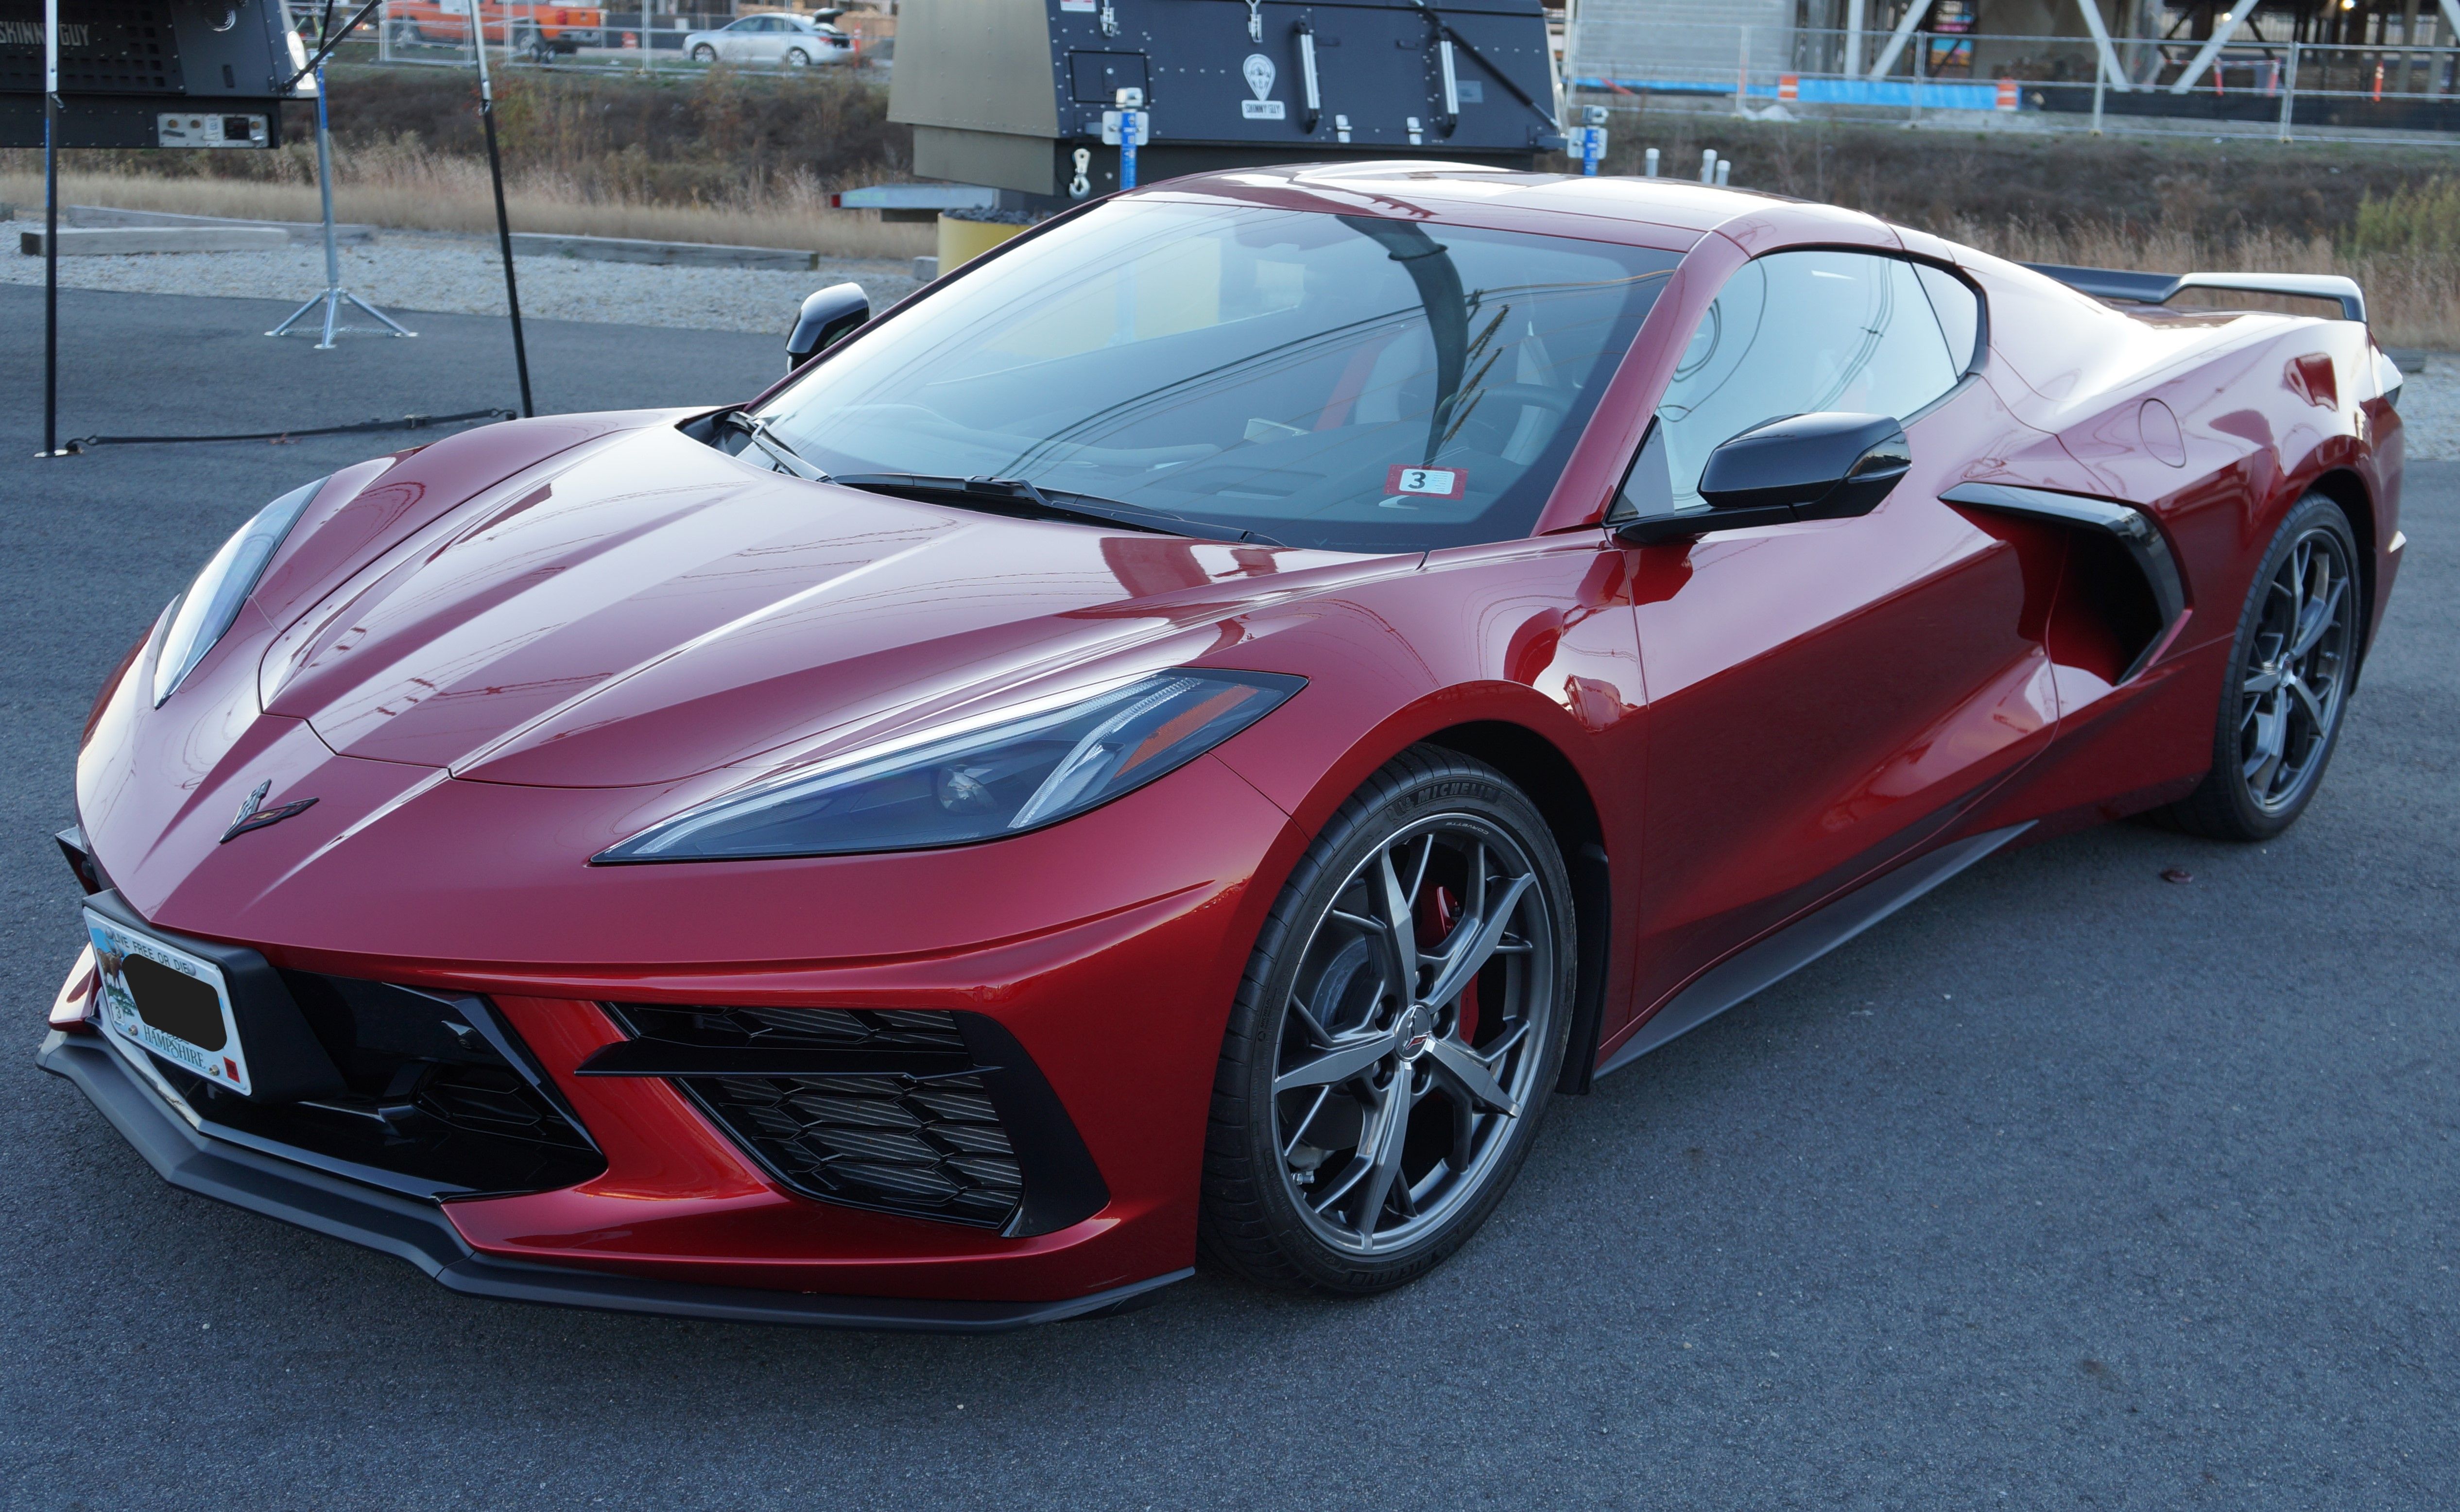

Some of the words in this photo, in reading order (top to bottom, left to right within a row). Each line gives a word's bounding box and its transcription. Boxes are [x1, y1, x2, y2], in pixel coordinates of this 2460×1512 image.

[0, 21, 46, 45] SKINN
[59, 24, 89, 46] GUY
[1245, 103, 1267, 113] SKINNY
[1269, 103, 1280, 113] GUY
[1408, 472, 1426, 489] 3
[1417, 782, 1497, 803] MICHELIN
[1445, 822, 1489, 835] CORVETTE
[113, 932, 130, 948] LIVE
[133, 941, 154, 960] FREE
[158, 953, 170, 966] OR
[174, 959, 189, 974] DIE
[116, 1006, 121, 1019] 3
[1260, 997, 1271, 1029] MICHELIN
[143, 1024, 206, 1069] HAMPSHIRE
